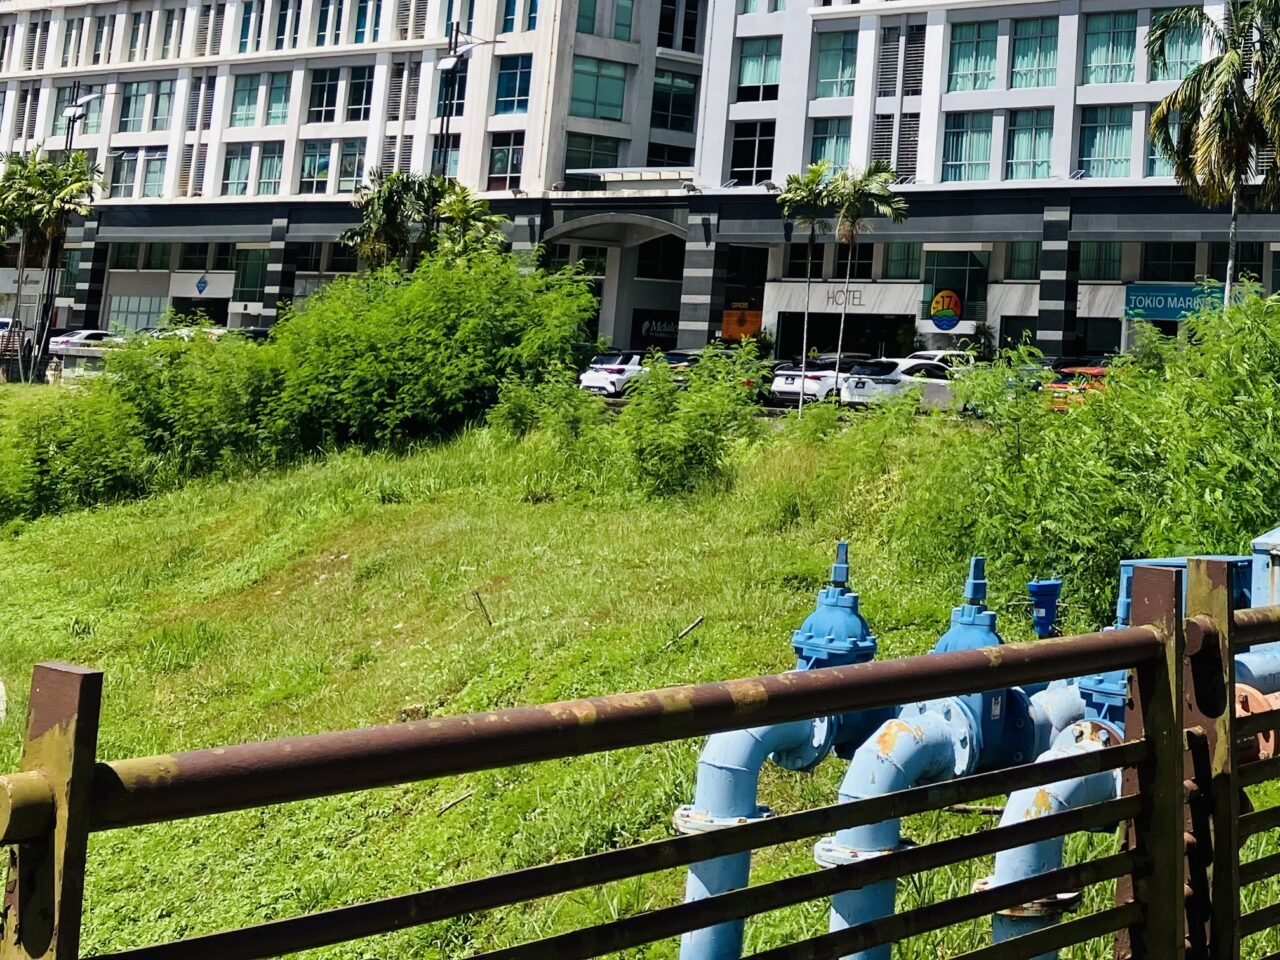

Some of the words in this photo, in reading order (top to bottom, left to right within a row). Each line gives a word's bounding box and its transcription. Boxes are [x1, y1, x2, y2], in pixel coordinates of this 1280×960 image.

[827, 290, 865, 307] HOTEL
[941, 295, 953, 310] 17
[1130, 296, 1165, 308] TOKIO
